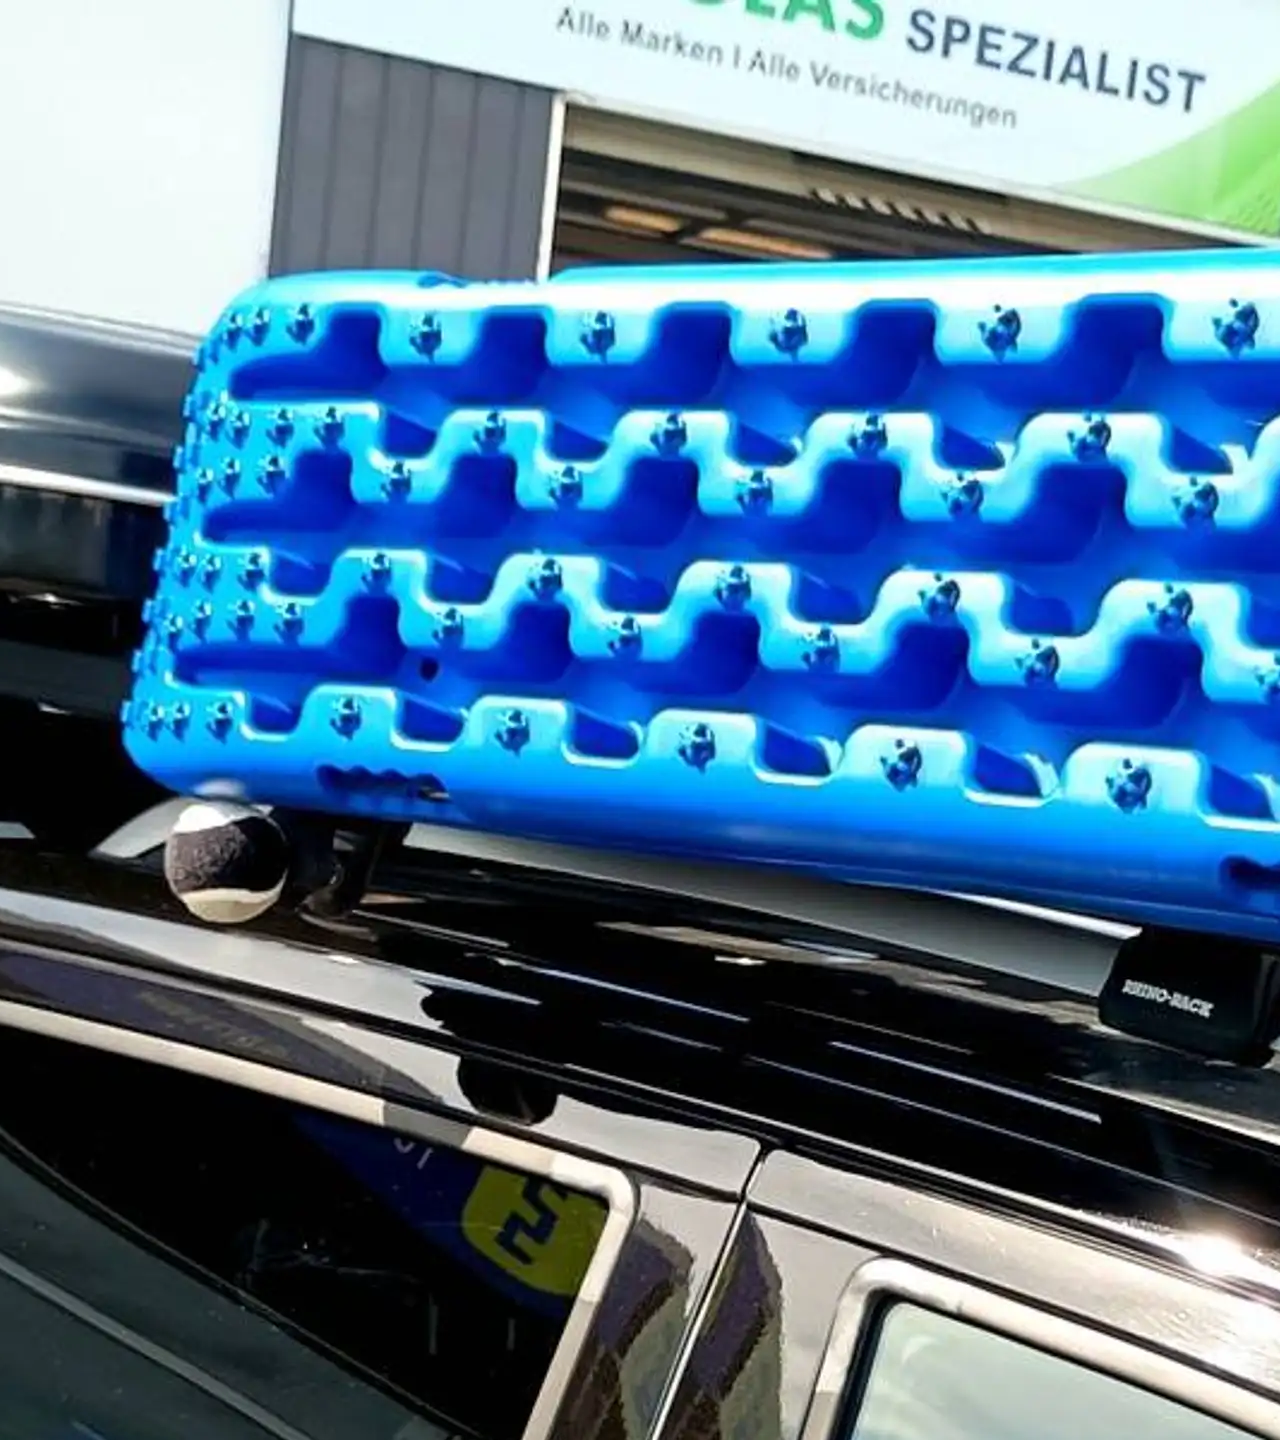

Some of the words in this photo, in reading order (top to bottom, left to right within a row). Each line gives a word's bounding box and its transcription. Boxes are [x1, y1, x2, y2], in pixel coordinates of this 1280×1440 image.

[556, 6, 610, 39] Alle
[621, 19, 724, 67] Marken
[748, 48, 801, 82] Alle
[809, 59, 1017, 129] Versicherungen
[906, 9, 1206, 113] SPEZIALIST
[1121, 978, 1214, 1019] RHINO-RACK
